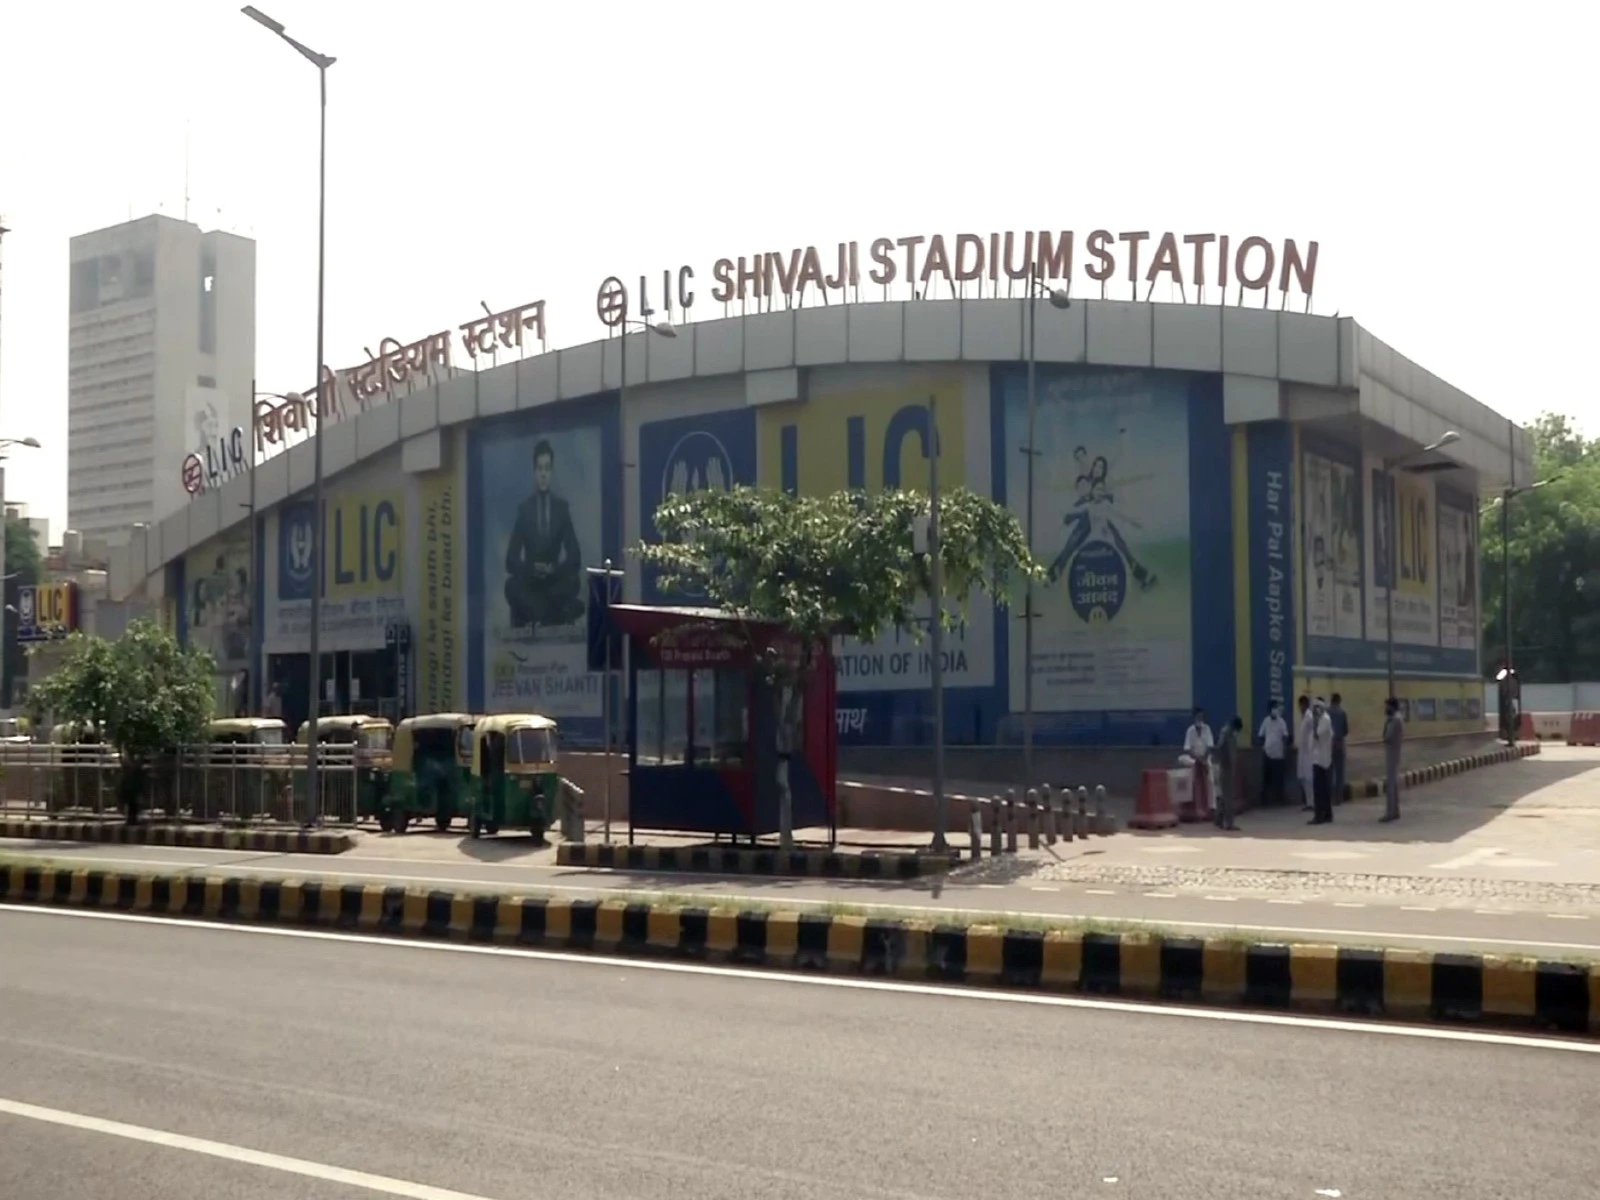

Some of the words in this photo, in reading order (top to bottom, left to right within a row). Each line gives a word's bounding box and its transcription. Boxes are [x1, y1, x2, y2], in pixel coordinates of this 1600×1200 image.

[639, 266, 695, 316] LIC
[711, 240, 858, 300] SHIVAJI
[869, 230, 1075, 284] STADIUM
[1085, 229, 1319, 295] STATION
[207, 427, 243, 478] LIC
[337, 331, 452, 400] स्टेडियम
[459, 300, 547, 358] स्टेशन
[1266, 471, 1282, 513] Har
[334, 500, 397, 585] LIC
[1267, 521, 1284, 558] Pal
[38, 588, 63, 621] LIC
[1265, 565, 1285, 641] Aapke
[889, 652, 913, 675] OF
